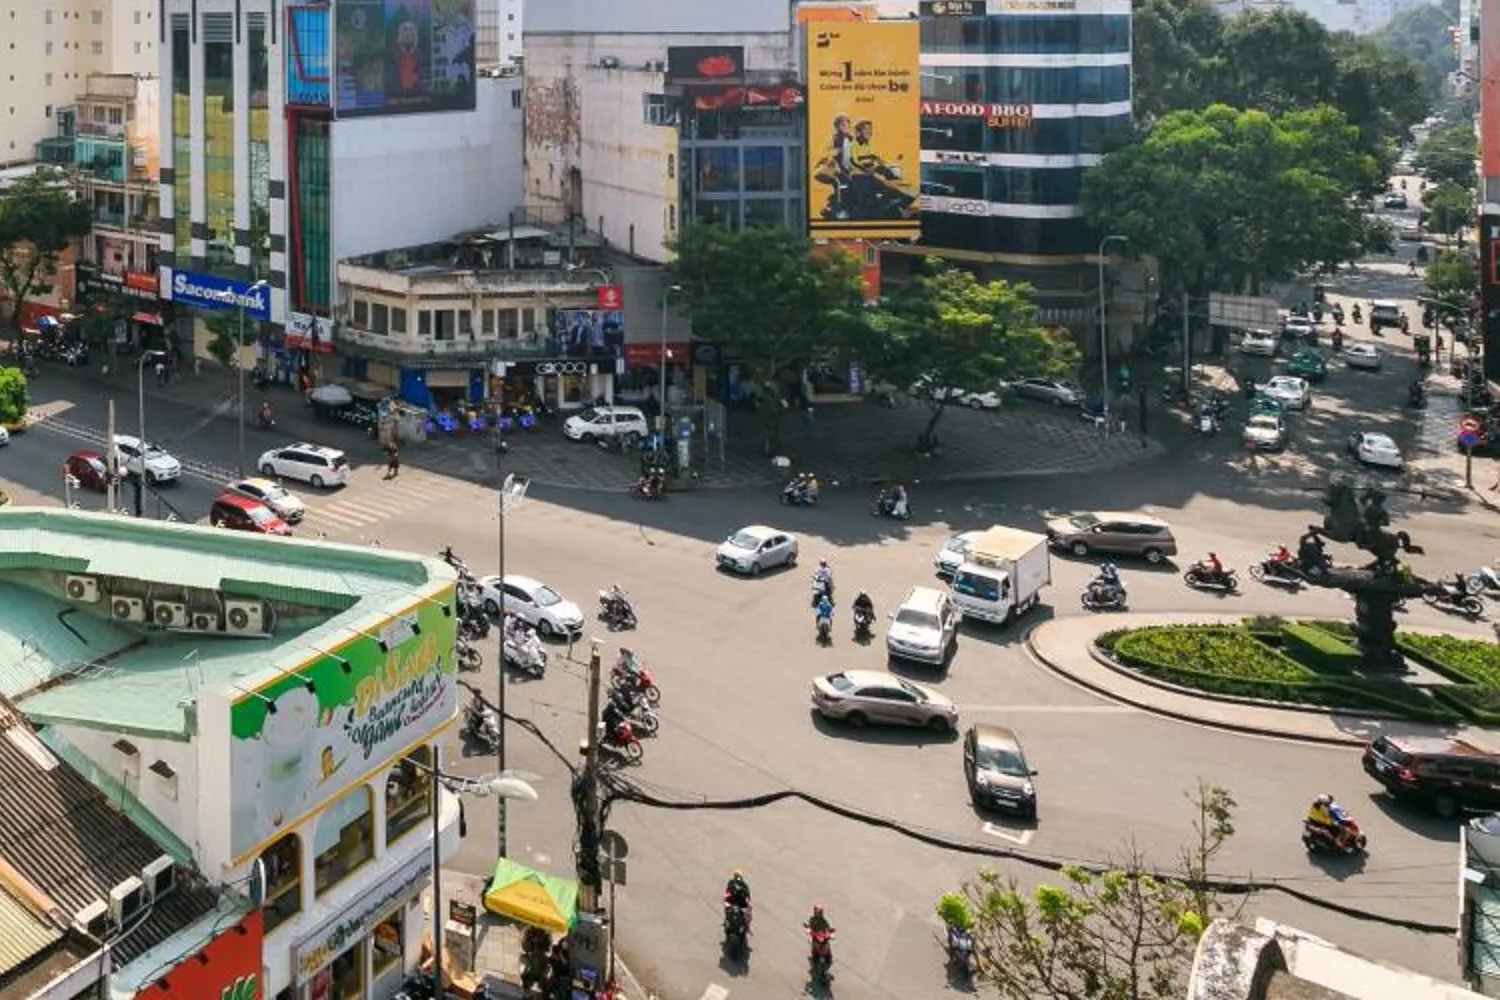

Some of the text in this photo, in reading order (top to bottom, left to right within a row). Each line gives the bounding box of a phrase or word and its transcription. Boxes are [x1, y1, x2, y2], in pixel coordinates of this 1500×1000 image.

[842, 60, 853, 82] 1
[889, 79, 909, 93] be
[920, 102, 1030, 118] AFOOD BBQ
[174, 274, 265, 311] Sacombank
